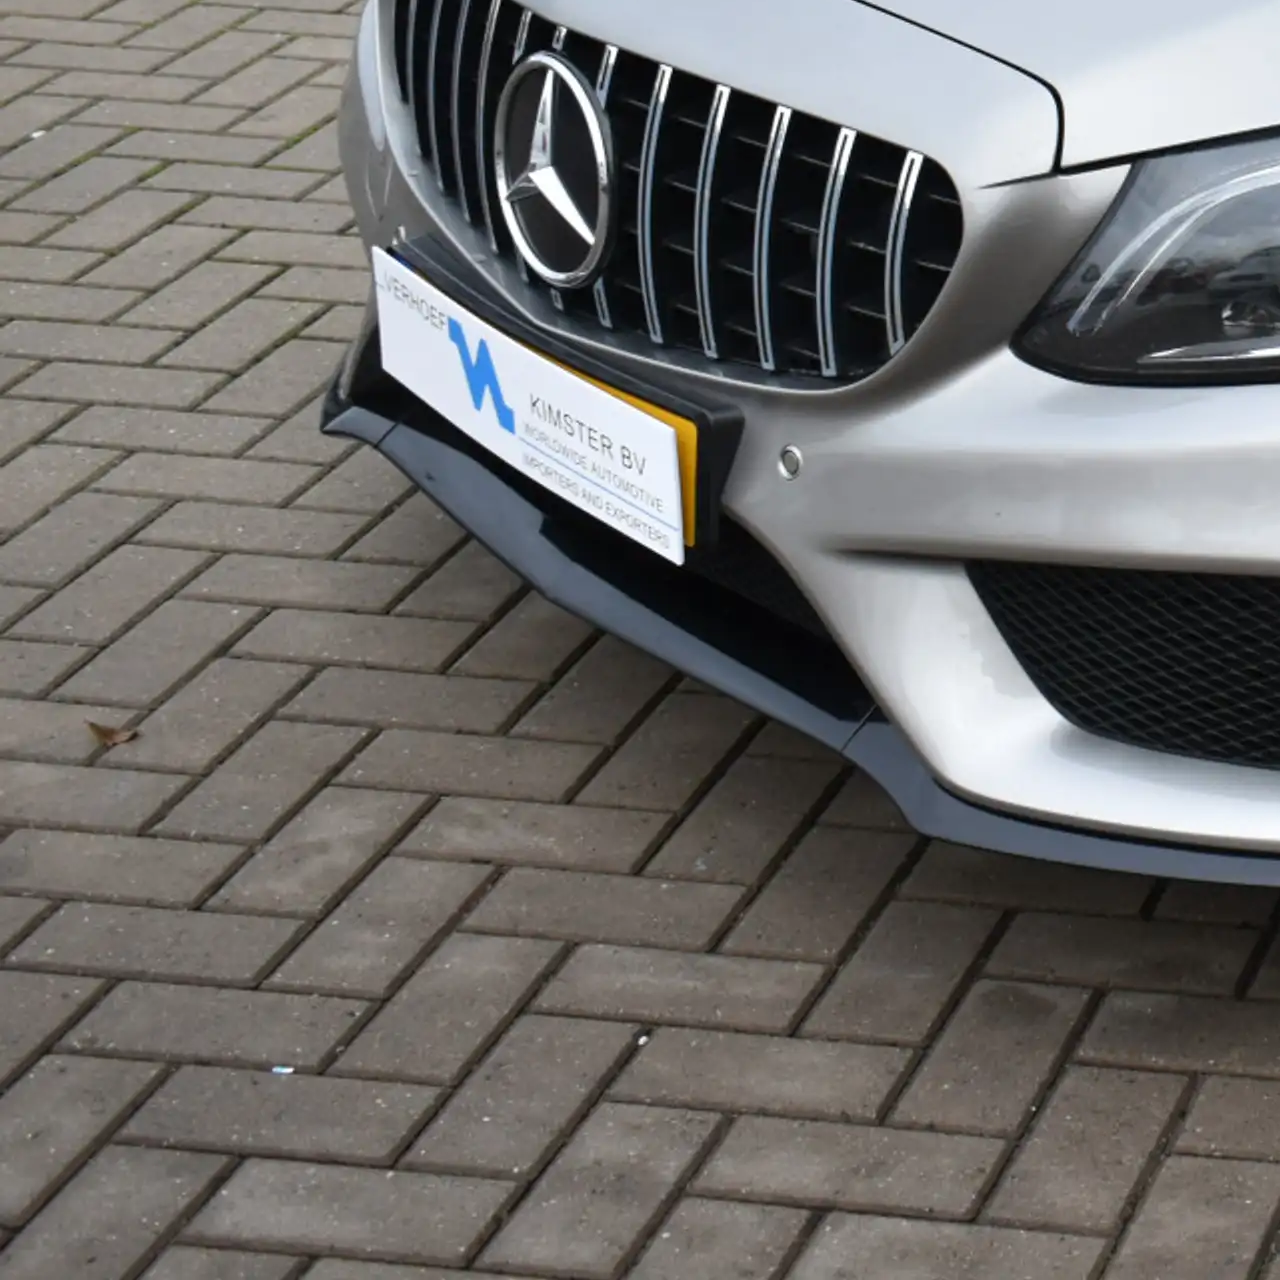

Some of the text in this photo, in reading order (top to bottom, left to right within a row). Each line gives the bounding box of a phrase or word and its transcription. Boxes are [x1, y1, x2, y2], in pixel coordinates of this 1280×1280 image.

[523, 422, 665, 514] WORLDWIDE AUTOMOTIVE
[530, 393, 647, 476] KIMSTER BV
[522, 452, 671, 550] IMPORTERS AND EXPORTERS
